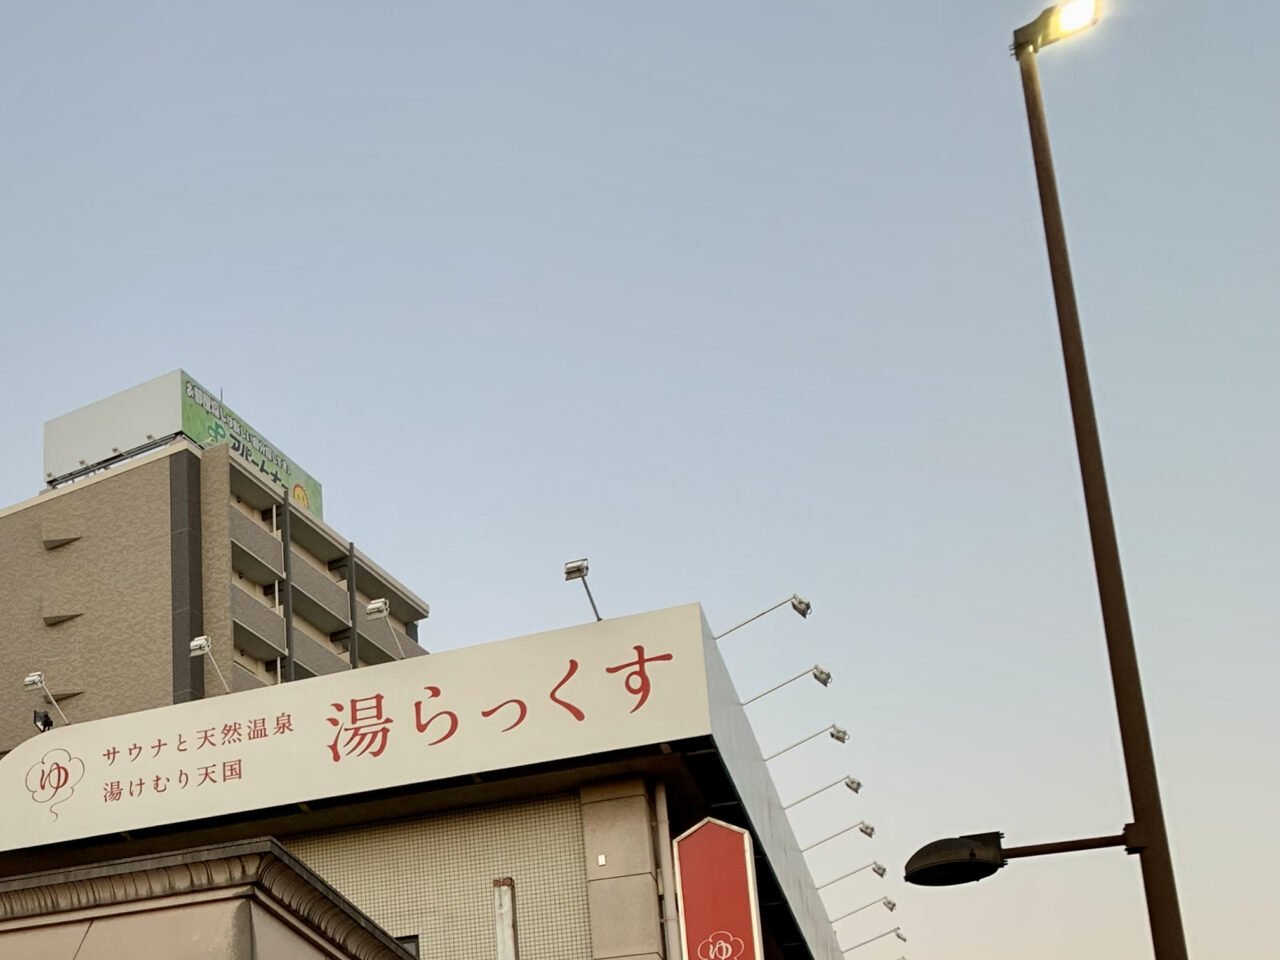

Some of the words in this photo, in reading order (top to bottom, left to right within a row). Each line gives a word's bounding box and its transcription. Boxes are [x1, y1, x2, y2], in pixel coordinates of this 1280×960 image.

[326, 644, 673, 763] 湯らっくす
[102, 711, 294, 767] サウナと天然温泉
[102, 758, 243, 804] 湯けむり天国
